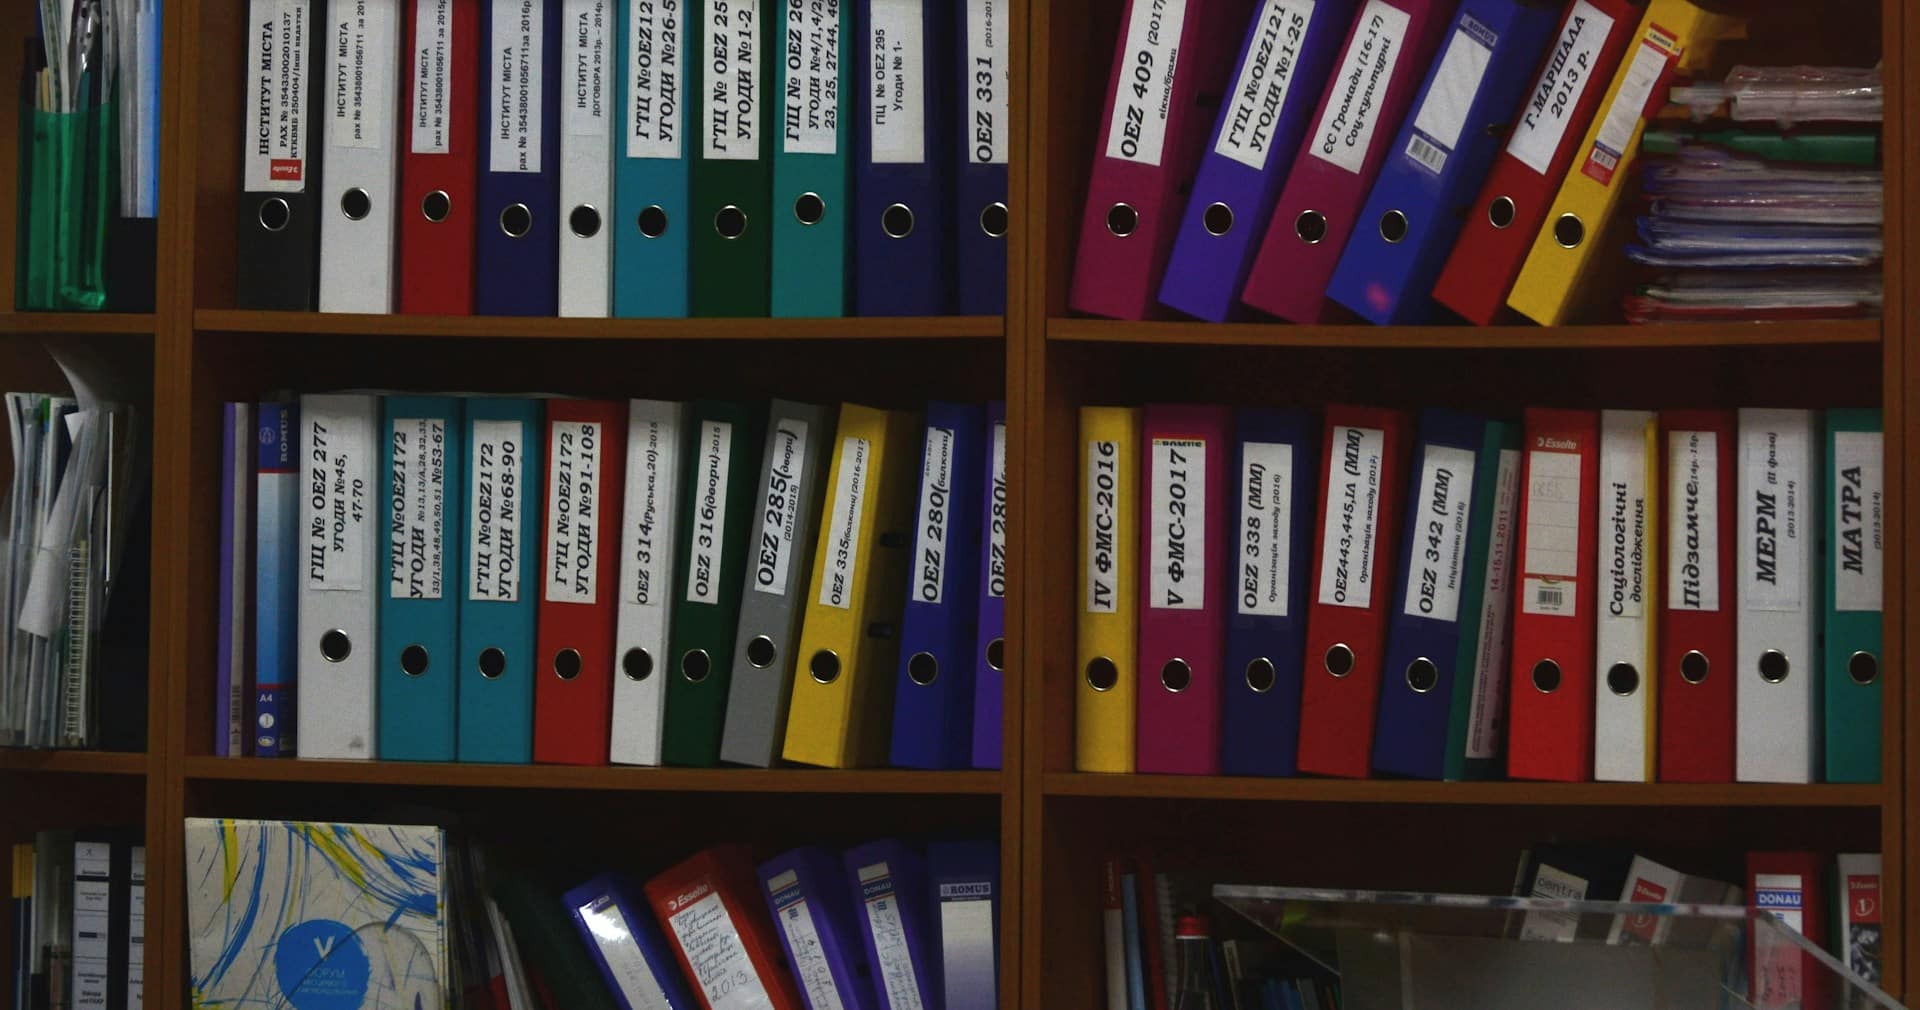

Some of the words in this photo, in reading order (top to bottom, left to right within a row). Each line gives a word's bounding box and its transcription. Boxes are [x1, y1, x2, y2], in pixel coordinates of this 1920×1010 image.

[262, 21, 272, 71] МІСТА
[339, 22, 348, 57] МІСТА
[579, 13, 588, 48] МІСТА
[788, 29, 802, 70] OEZ
[826, 24, 838, 70] 27-44,
[876, 29, 885, 50] 295
[503, 48, 512, 82] МІСТА
[714, 33, 727, 74] OEZ
[876, 54, 885, 80] OEZ
[893, 57, 902, 70] №
[337, 64, 347, 117] ІНСТИТУТ
[354, 123, 362, 139] рах
[358, 19, 364, 28] за
[434, 131, 442, 146] рах
[438, 28, 444, 38] за
[578, 54, 587, 108] ІНСТИТУТ
[714, 82, 727, 103] №
[788, 78, 801, 99] №
[825, 76, 837, 99] 25,
[876, 84, 885, 98] №
[893, 74, 904, 111] Угоди
[977, 57, 992, 102] 331
[1323, 133, 1336, 154] ЄС
[1332, 68, 1362, 132] Громади
[1359, 14, 1384, 65] (16-17)
[1346, 37, 1391, 147] Соц-культурні
[1551, 68, 1578, 118] 2013
[259, 76, 271, 155] ІНСТИТУТ
[281, 111, 288, 121] №
[419, 82, 428, 127] ІНСТИТУТ
[501, 85, 511, 139] ІНСТИТУТ
[636, 96, 651, 138] ГТЦ
[660, 71, 675, 142] УГОДИ
[738, 69, 753, 139] УГОДИ
[809, 77, 821, 129] УГОДИ
[825, 106, 837, 129] 23,
[1121, 105, 1143, 158] OEZ
[1133, 51, 1152, 98] 409
[1250, 82, 1280, 152] УГОДИ
[519, 137, 526, 148] №
[713, 109, 728, 152] ГТЦ
[977, 111, 992, 162] OEZ
[1228, 104, 1253, 148] ГТЦ
[520, 152, 528, 170] рах
[314, 422, 327, 462] 277
[1344, 429, 1364, 476] (ММ)
[313, 468, 326, 510] OEZ
[353, 479, 363, 522] 47-70
[1096, 442, 1113, 573] ФМС-2016
[1248, 463, 1265, 510] (ММ)
[1273, 474, 1281, 504] (2016)
[1432, 468, 1453, 516] (ММ)
[312, 517, 325, 539] №
[334, 499, 346, 552] УГОДИ
[1168, 448, 1186, 583] ФМС-2017
[1246, 516, 1260, 557] 338
[1272, 506, 1280, 540] заходу
[1360, 524, 1372, 583] Організація
[1366, 488, 1376, 521] заходу
[1757, 490, 1776, 585] МЕРМ
[1842, 466, 1863, 575] МАТРА
[392, 542, 405, 584] ГТЦ
[411, 526, 426, 598] УГОДИ
[499, 527, 514, 599] УГОДИ
[555, 541, 570, 585] ГТЦ
[576, 522, 592, 595] УГОДИ
[758, 532, 779, 585] OEZ
[1426, 521, 1444, 562] 342
[1610, 482, 1627, 615] Соціологічні
[1630, 498, 1643, 602] дослідження
[477, 552, 490, 595] ГТЦ
[637, 570, 649, 604] OEZ
[696, 554, 710, 596] OEZ
[832, 573, 844, 605] OEZ
[923, 548, 940, 601] OEZ
[1095, 580, 1111, 608] IV
[1244, 563, 1258, 608] OEZ
[1269, 543, 1278, 602] Організація
[1419, 568, 1437, 613] OEZ
[1168, 589, 1184, 605] V
[259, 694, 273, 703] A4
[950, 884, 990, 894] ROMUS
[1758, 893, 1802, 905] DONAU
